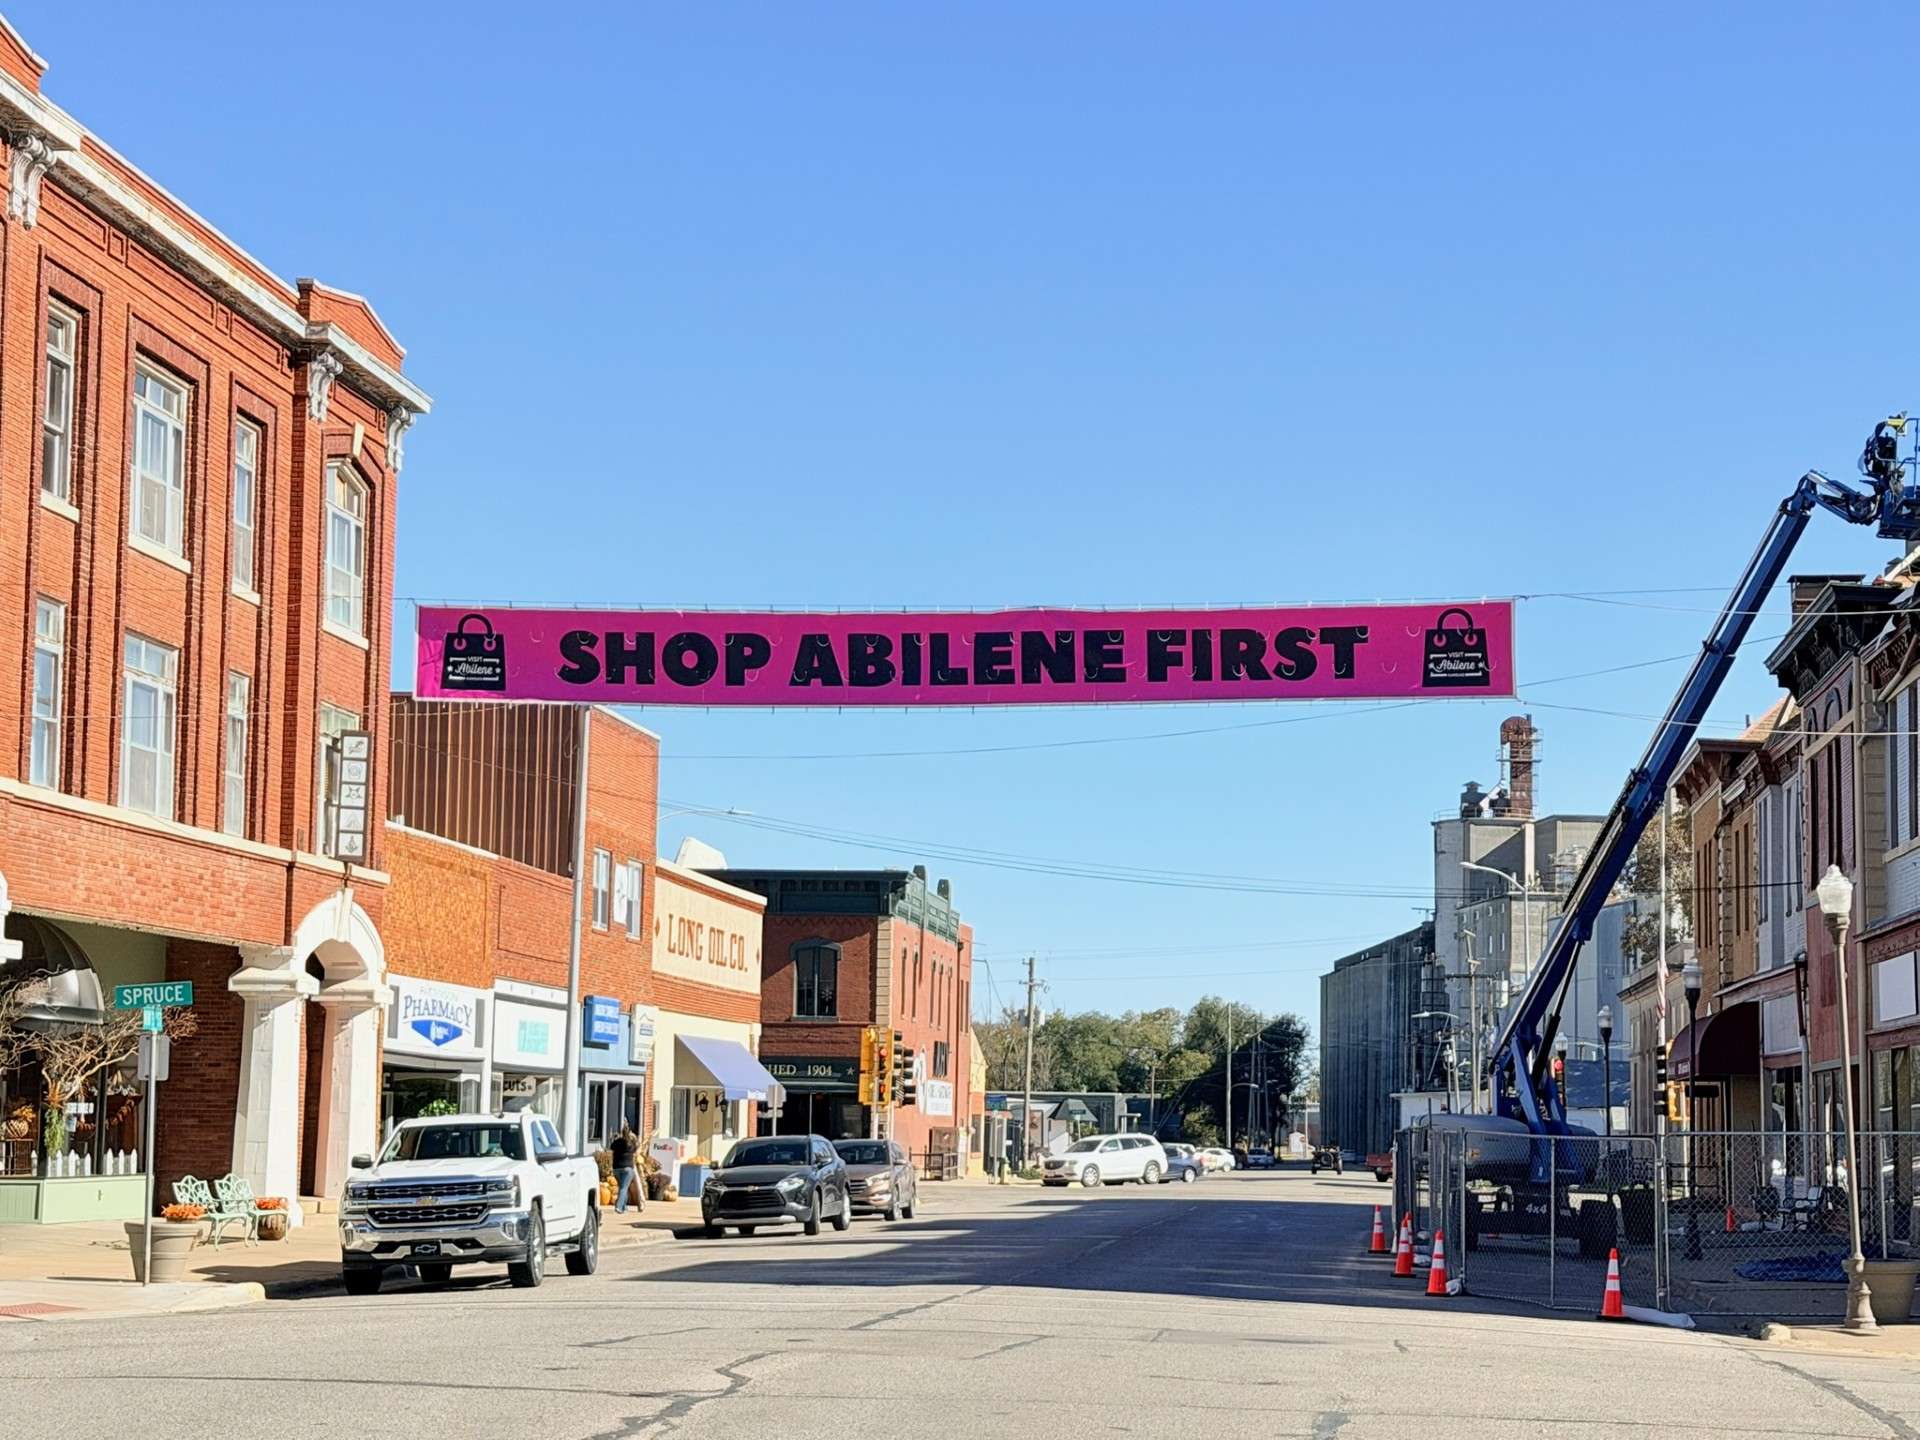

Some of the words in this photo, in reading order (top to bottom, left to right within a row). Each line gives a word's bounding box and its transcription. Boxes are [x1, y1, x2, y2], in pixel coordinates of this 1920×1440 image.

[557, 630, 772, 687] SHOP
[788, 629, 1127, 688] ABILENE
[1146, 627, 1369, 683] FIRST
[1436, 659, 1475, 670] Abilene
[454, 662, 493, 675] Abilene
[667, 912, 704, 961] LONG
[708, 926, 728, 968] OIL
[730, 933, 748, 973] CO.
[122, 985, 184, 1005] SPRUCE
[403, 994, 473, 1028] PHARMACY
[764, 1063, 798, 1076] HED
[806, 1064, 833, 1077] 1904
